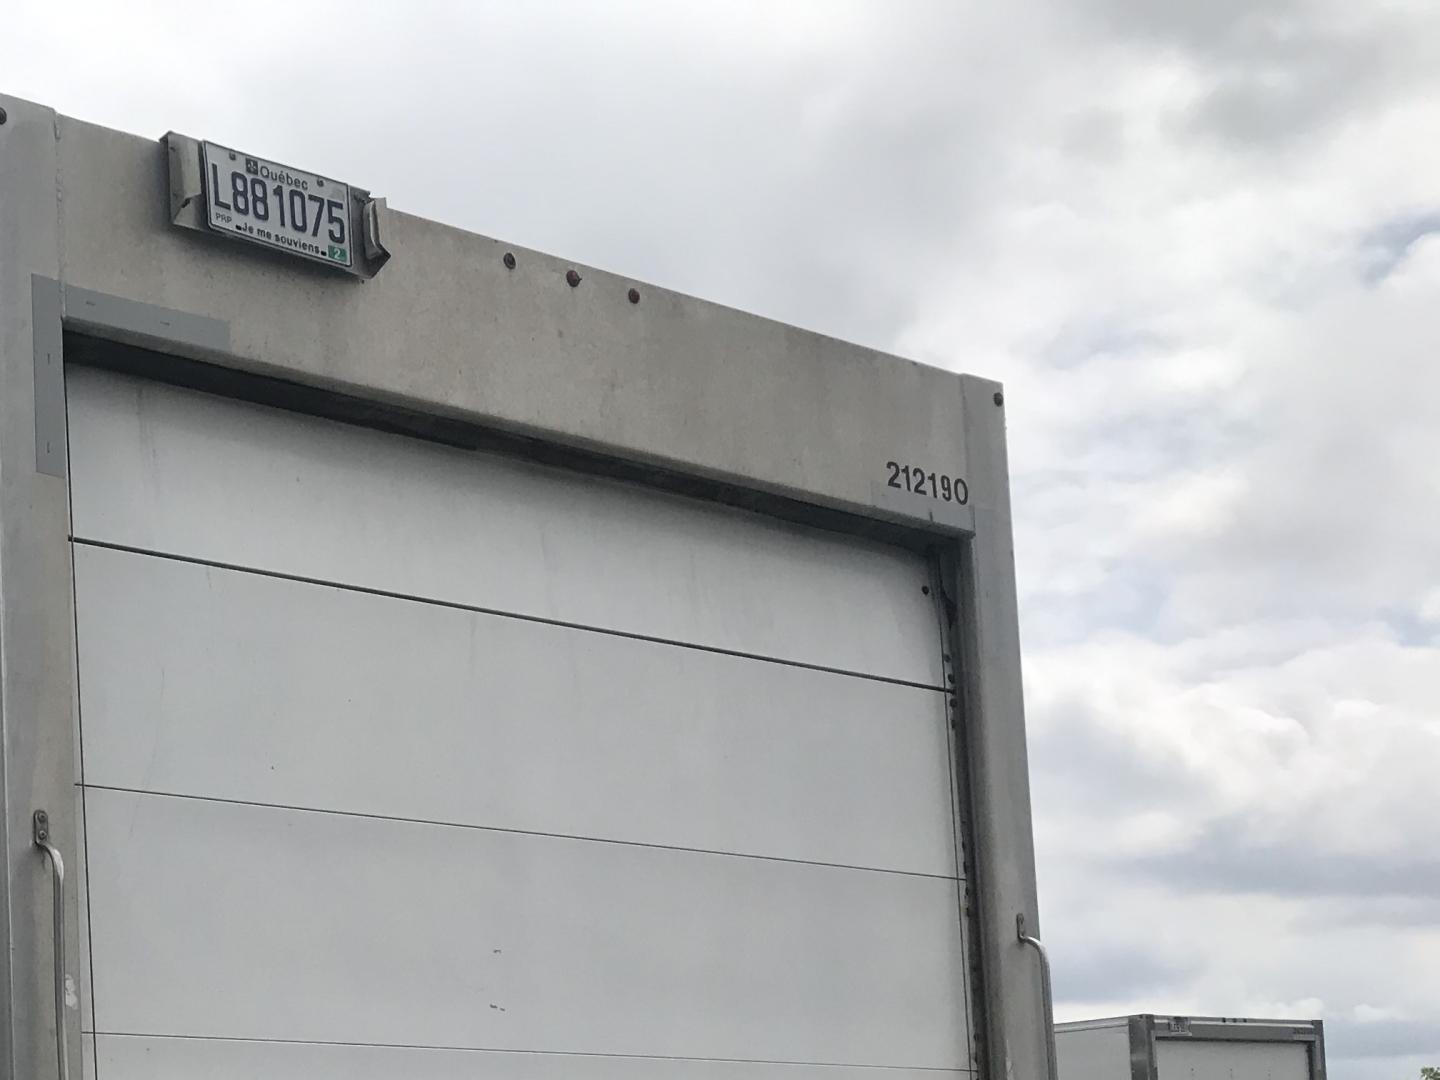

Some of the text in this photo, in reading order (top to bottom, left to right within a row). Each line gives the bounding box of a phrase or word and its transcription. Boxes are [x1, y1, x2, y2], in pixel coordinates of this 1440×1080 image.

[260, 165, 308, 190] Québec
[212, 163, 345, 244] L881075
[242, 222, 320, 254] Je me souviens
[886, 461, 968, 505] 212190
